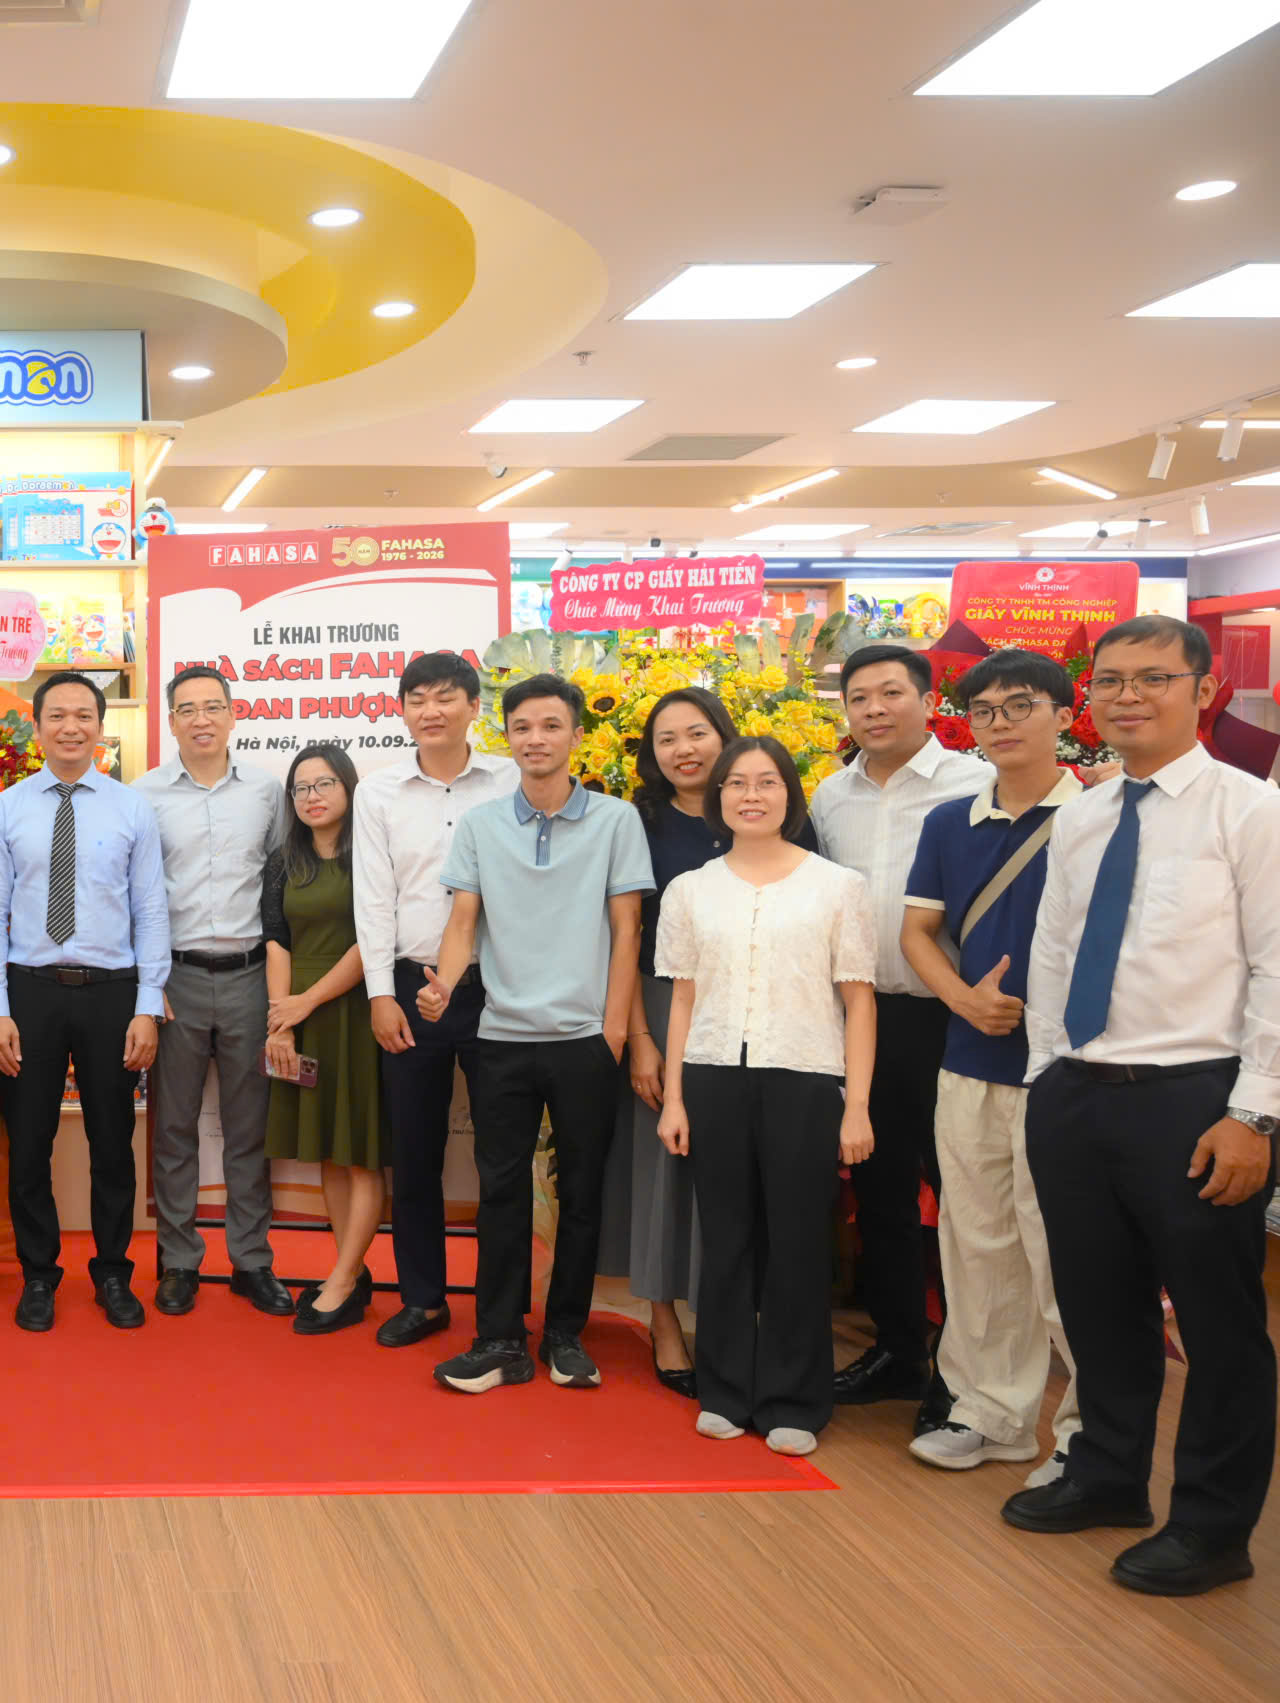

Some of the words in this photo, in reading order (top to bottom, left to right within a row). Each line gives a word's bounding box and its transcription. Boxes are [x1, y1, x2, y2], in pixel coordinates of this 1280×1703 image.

[209, 543, 318, 566] FAHASA
[332, 536, 380, 567] 50
[381, 538, 445, 550] FAHASA
[381, 552, 407, 561] 1976
[417, 551, 444, 559] 2026
[559, 572, 598, 593] CÔNG
[603, 573, 621, 591] TY
[624, 571, 644, 590] CP
[648, 563, 684, 589] GIẤY
[688, 562, 715, 587] HẢI
[719, 559, 756, 585] TIẾN
[564, 598, 597, 620] Chúc
[600, 595, 642, 621] Mừng
[646, 594, 684, 617] Khai
[690, 593, 744, 617] Trương
[965, 605, 1007, 620] GIẤY
[1011, 606, 1055, 621] VĨNH
[1060, 610, 1116, 624] THỊNH
[253, 620, 273, 645] LỄ
[279, 626, 321, 645] KHAI
[327, 622, 399, 642] TRƯƠNG
[243, 654, 322, 681] SÁCH
[300, 692, 404, 723] PHƯỢN
[236, 737, 261, 750] Hà
[266, 735, 301, 753] Nội,
[358, 735, 419, 748] 10.09.2
